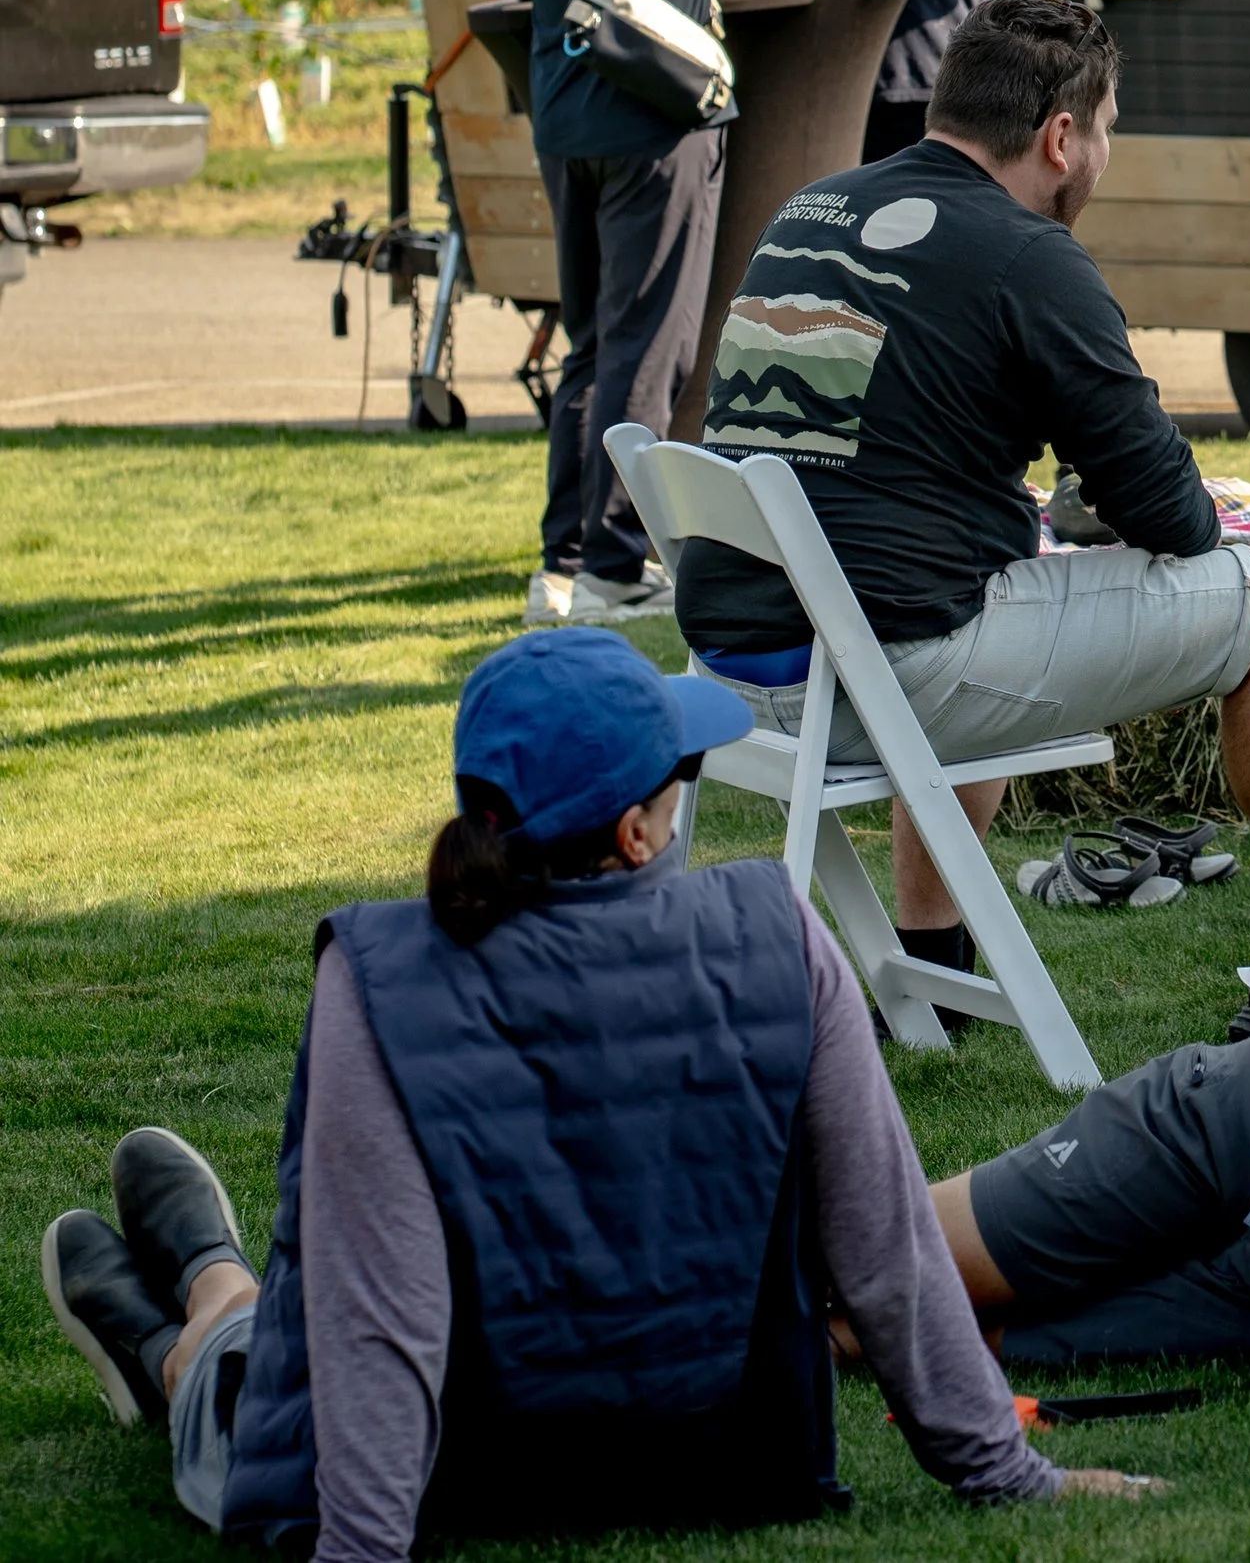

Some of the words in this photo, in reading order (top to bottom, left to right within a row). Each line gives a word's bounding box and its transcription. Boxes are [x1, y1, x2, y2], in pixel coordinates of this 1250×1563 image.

[786, 193, 849, 209] COLUMBIA
[774, 206, 858, 227] SPORTSWEAR
[797, 454, 817, 464] OWN
[820, 457, 846, 468] TRAIL
